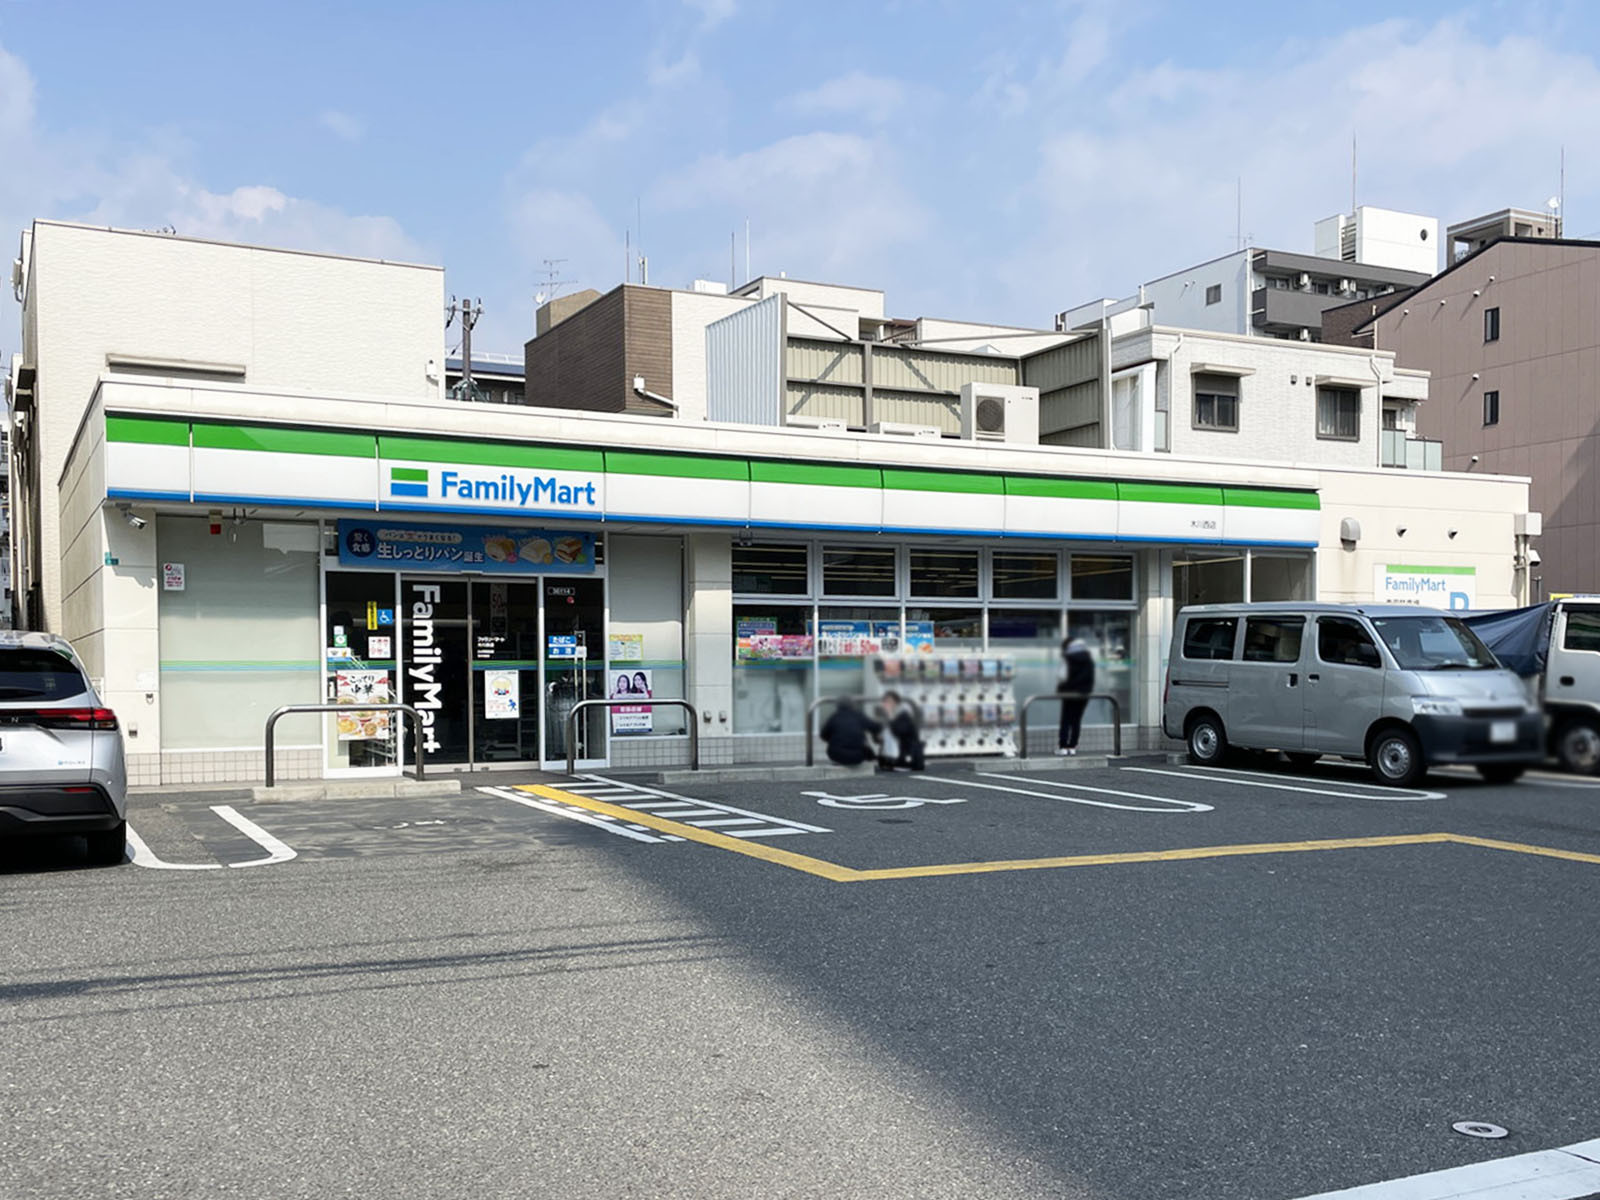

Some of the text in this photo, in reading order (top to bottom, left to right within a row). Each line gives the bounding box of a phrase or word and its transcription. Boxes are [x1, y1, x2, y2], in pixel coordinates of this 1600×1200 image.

[441, 471, 595, 506] FamilyMart
[1385, 576, 1447, 593] FamilyMart
[408, 584, 443, 753] FamilyMart
